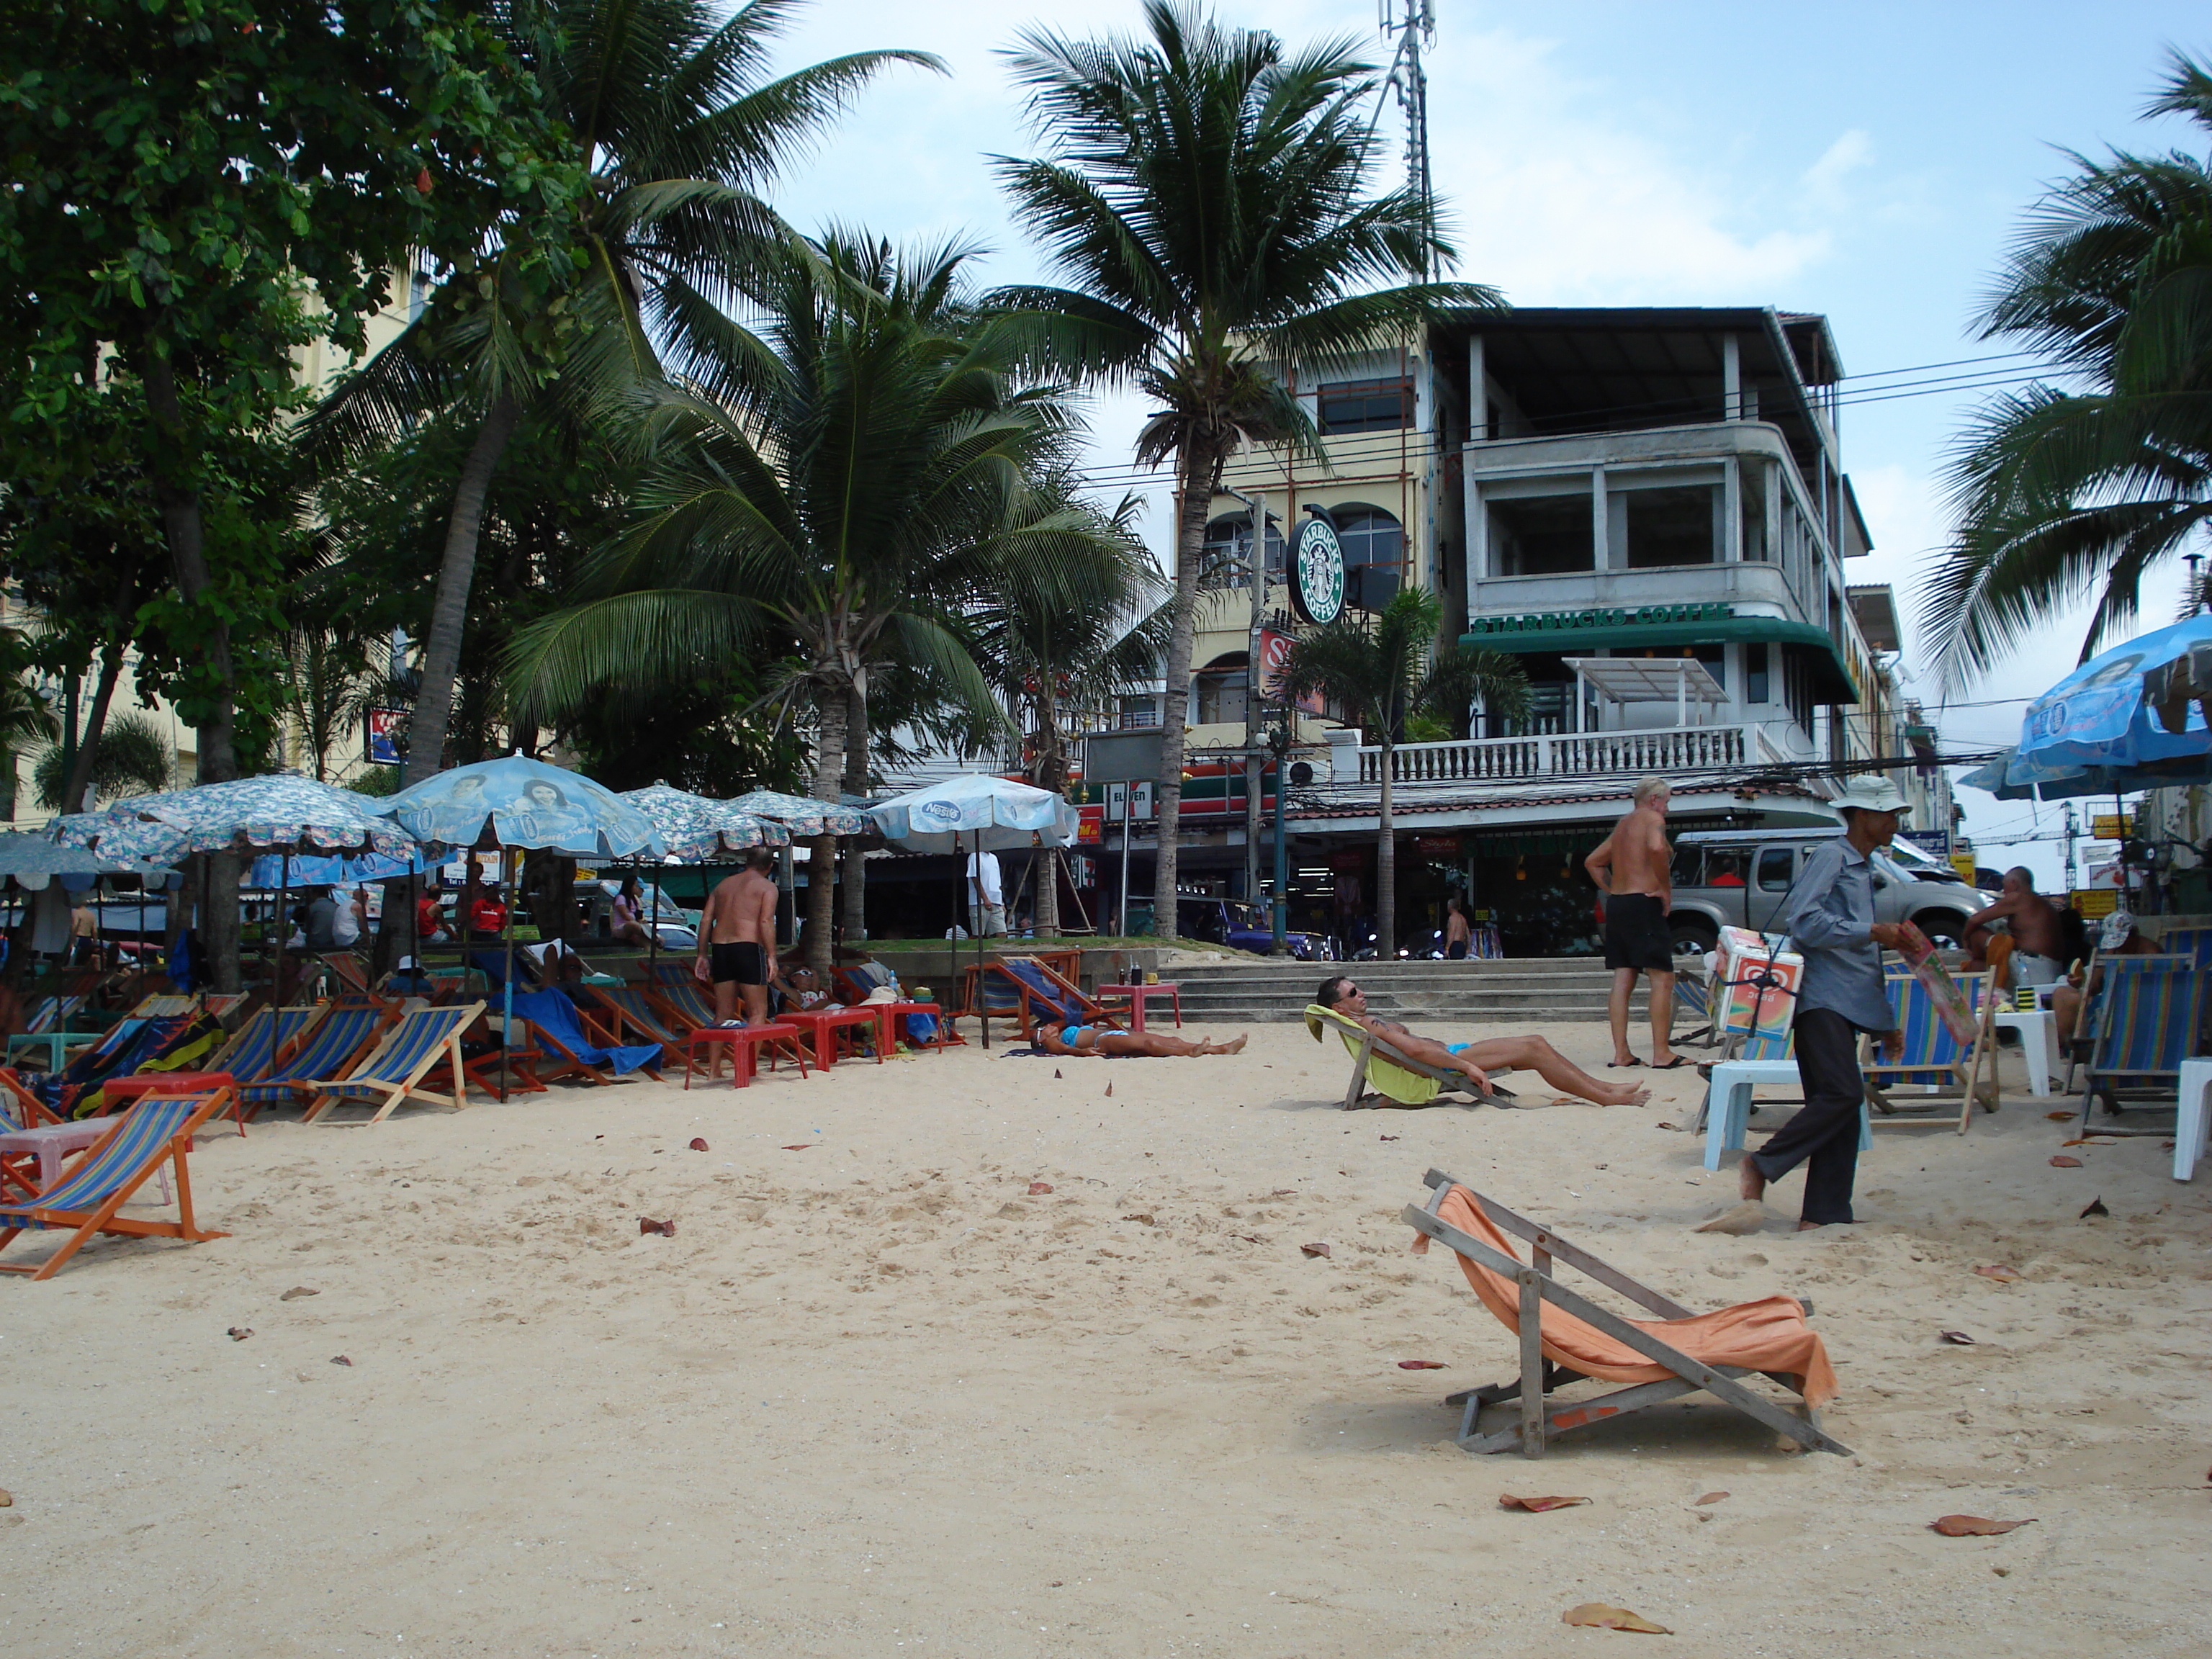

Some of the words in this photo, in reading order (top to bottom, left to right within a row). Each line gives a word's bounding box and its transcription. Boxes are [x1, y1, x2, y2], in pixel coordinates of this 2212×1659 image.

[1300, 525, 1341, 575] STARBUCKS
[1304, 587, 1337, 619] COFFEE
[1473, 608, 1627, 634] STARBUCKS
[1635, 602, 1731, 624] COFFEE
